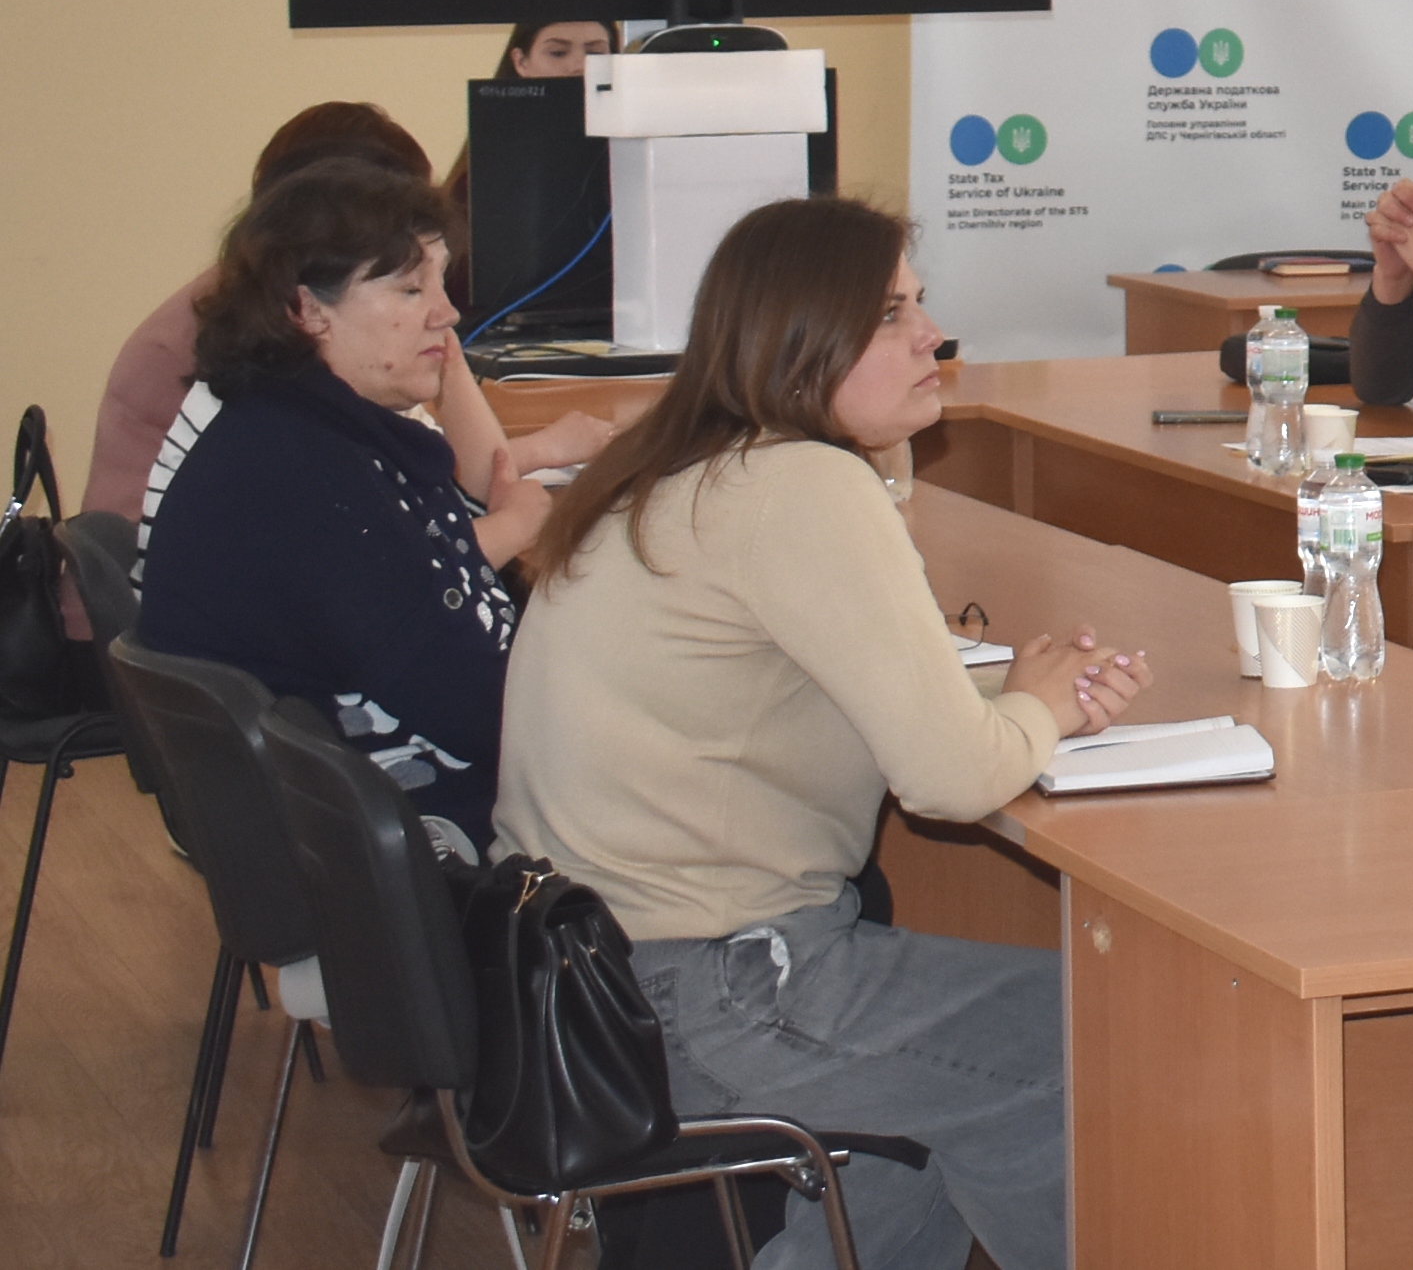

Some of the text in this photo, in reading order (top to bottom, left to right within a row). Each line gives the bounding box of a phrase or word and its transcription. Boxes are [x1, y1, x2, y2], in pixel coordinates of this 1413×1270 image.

[1148, 85, 1280, 96] Державна податкова
[1148, 99, 1247, 111] служба України
[1147, 120, 1246, 129] Головне управління
[1146, 132, 1167, 141] ДПС
[1180, 131, 1247, 140] Чернігівській
[1250, 130, 1286, 139] області
[1343, 166, 1400, 176] State Tax
[949, 173, 1004, 184] State Tax
[1343, 181, 1388, 191] Service
[948, 186, 1065, 199] Service of Ukraine
[1341, 200, 1365, 209] Main
[948, 206, 1089, 218] Main Directorate of the STS
[959, 220, 1005, 229] Chernihiv
[1009, 219, 1042, 229] region
